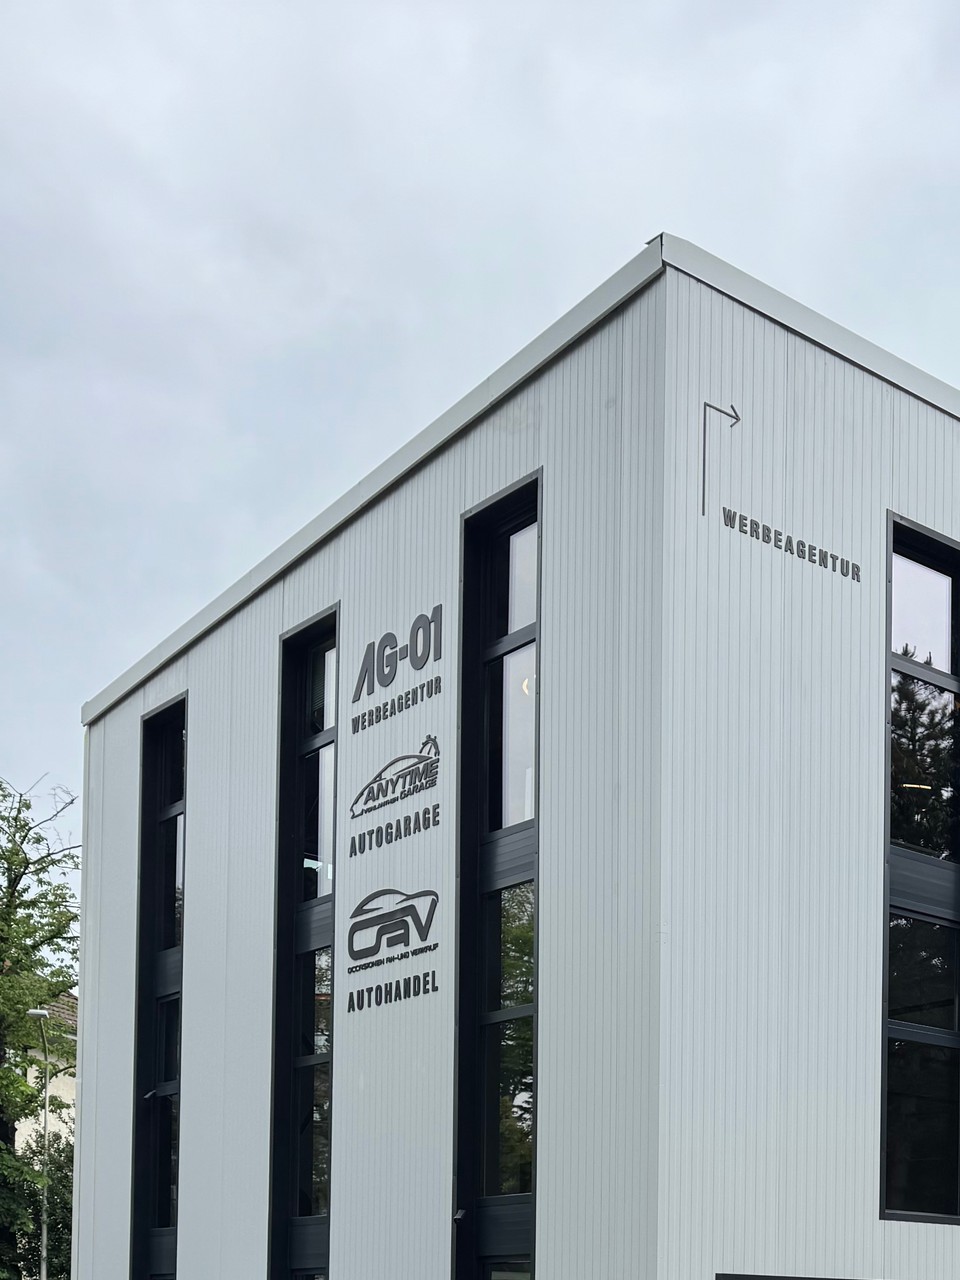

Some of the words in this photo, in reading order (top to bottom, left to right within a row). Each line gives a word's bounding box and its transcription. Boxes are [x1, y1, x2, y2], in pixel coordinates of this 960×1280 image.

[722, 506, 861, 583] WERBEAGENTUR
[351, 603, 443, 704] AG-01
[350, 675, 442, 735] WERBEAGENTUR
[363, 757, 440, 806] ANYTIME
[399, 776, 437, 801] GARAGE
[349, 803, 440, 859] AUTOGARAGE
[347, 970, 439, 1013] AUTOHANDEL
